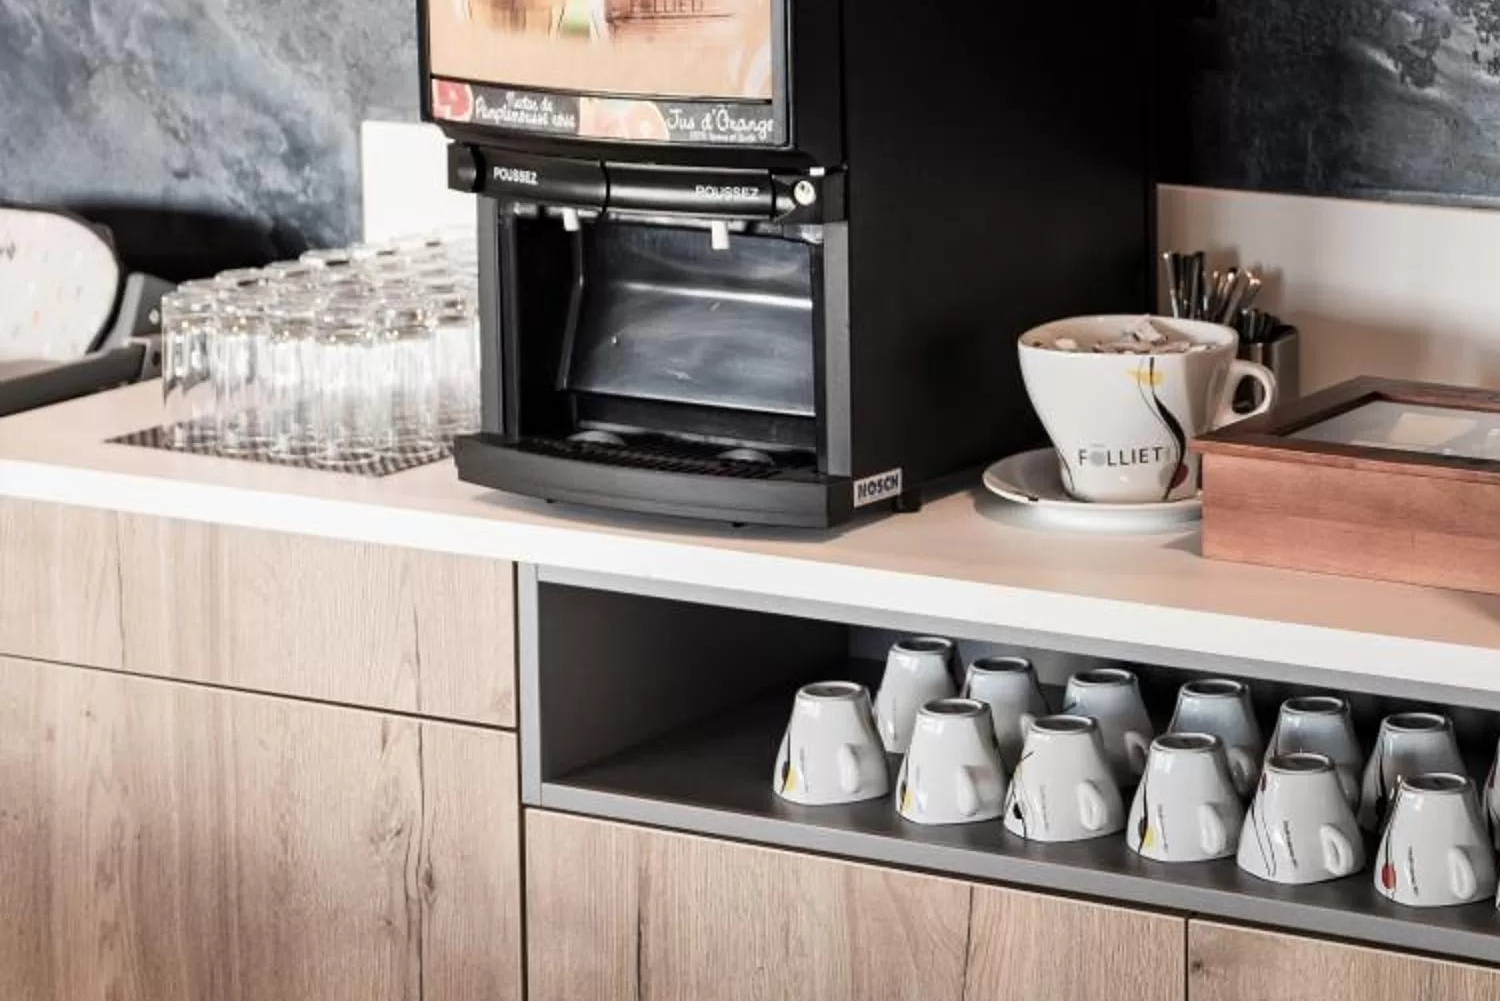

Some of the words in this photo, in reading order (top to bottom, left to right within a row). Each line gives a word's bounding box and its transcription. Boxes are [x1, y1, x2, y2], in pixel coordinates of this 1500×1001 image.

[668, 109, 695, 130] Jus
[493, 166, 539, 186] POUSSEZ
[695, 184, 760, 200] POUSSEZ
